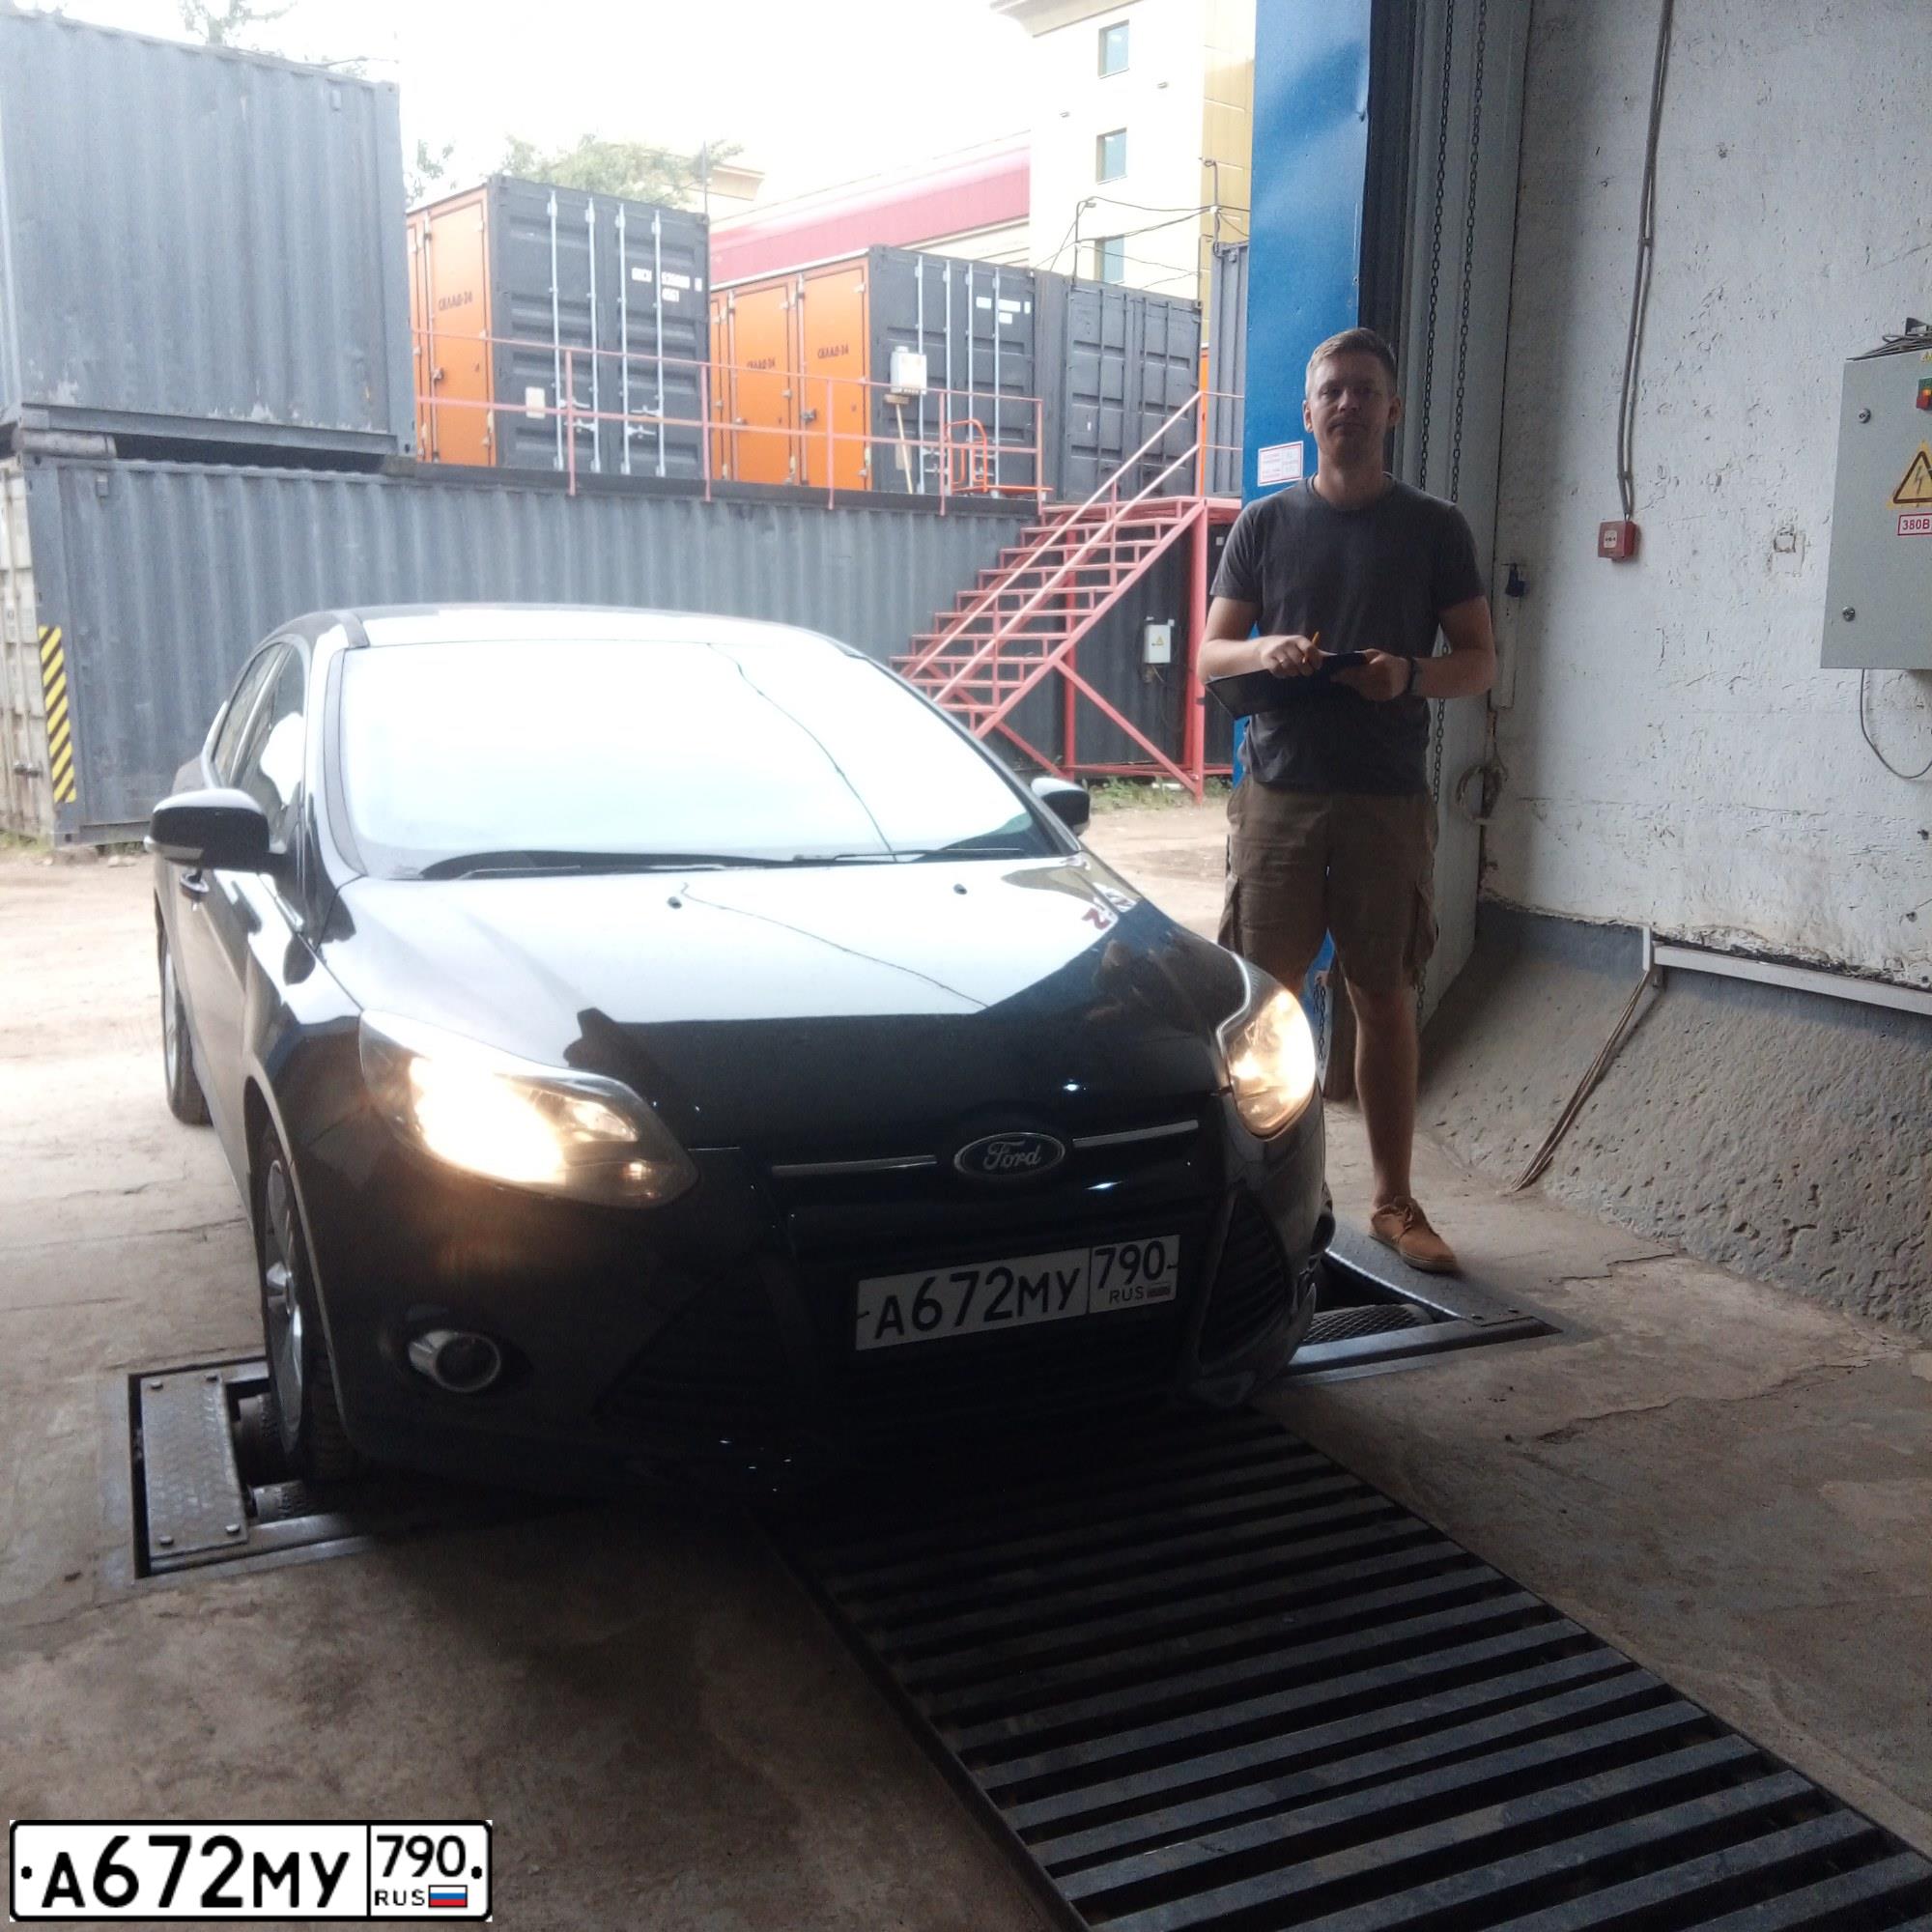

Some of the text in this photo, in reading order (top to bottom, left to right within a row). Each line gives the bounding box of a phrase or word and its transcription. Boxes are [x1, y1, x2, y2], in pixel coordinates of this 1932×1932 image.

[1902, 519, 1930, 530] 380В
[983, 1140, 1041, 1170] Ford
[874, 1240, 1166, 1340] А672МУ 790
[1108, 1286, 1145, 1303] RUS
